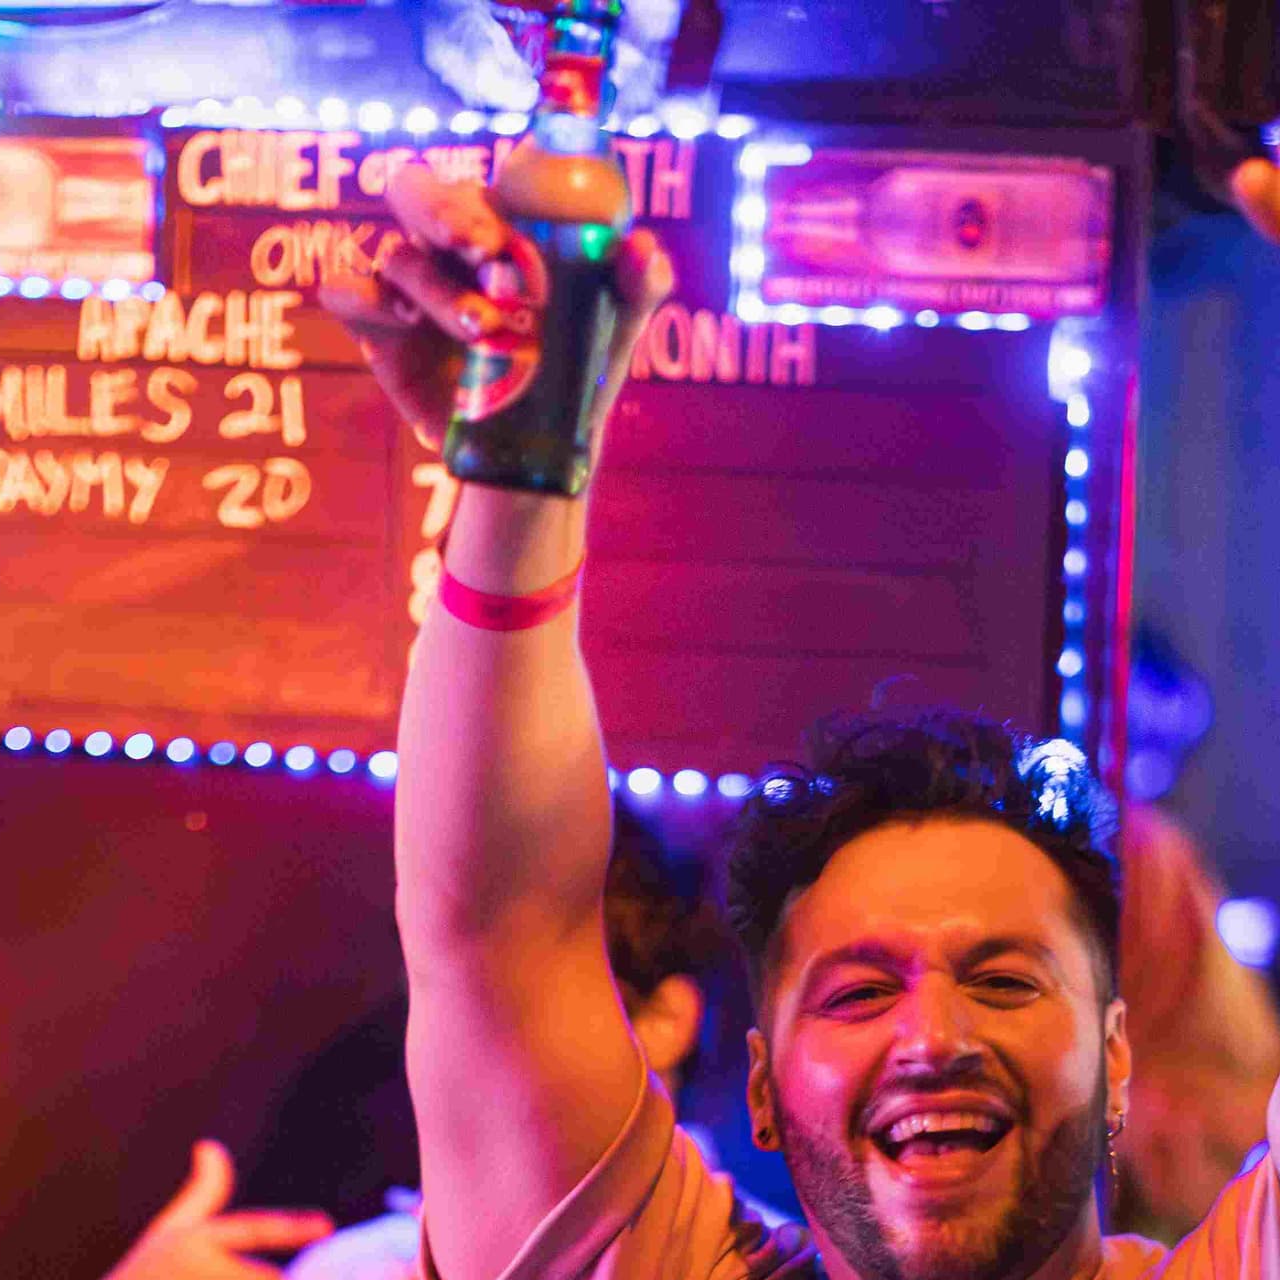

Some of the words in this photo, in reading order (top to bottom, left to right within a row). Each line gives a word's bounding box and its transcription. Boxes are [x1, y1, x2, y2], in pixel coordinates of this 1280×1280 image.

[178, 130, 361, 210] CHIEF
[78, 290, 303, 368] APACHE
[218, 373, 306, 447] 21
[202, 457, 312, 528] 20
